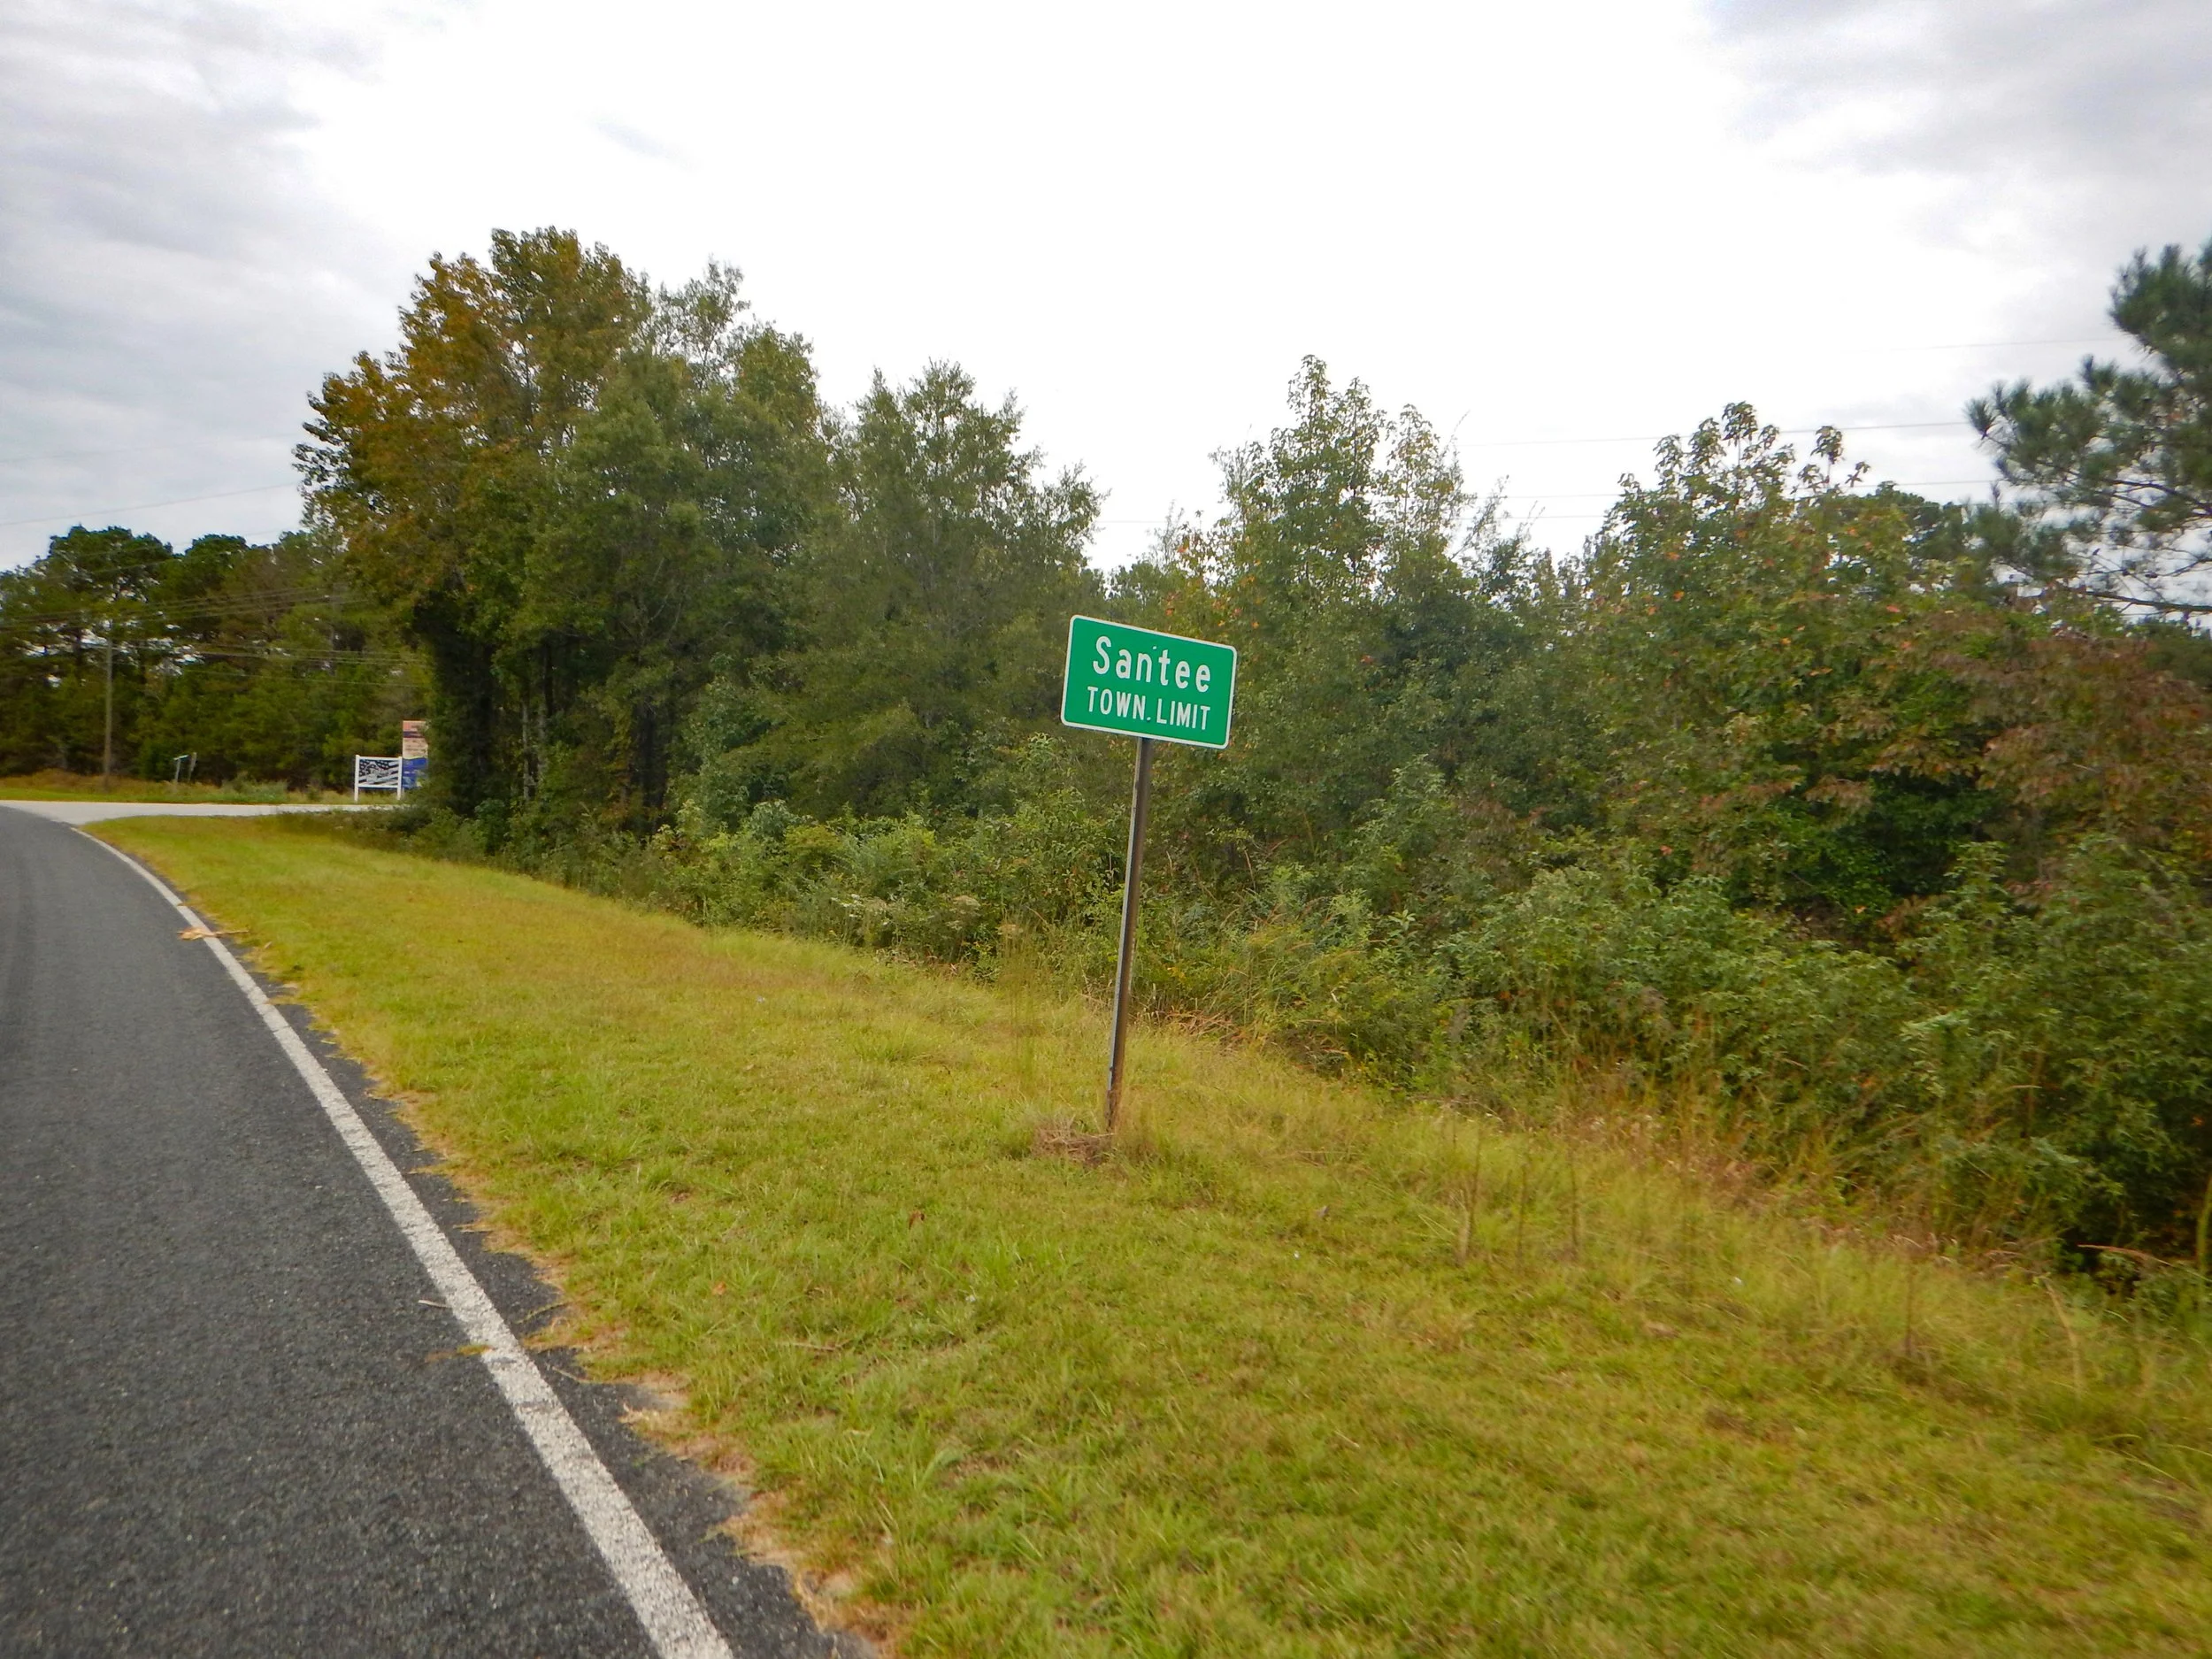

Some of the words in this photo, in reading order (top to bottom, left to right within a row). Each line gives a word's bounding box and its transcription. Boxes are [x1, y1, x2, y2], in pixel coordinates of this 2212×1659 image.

[1093, 636, 1210, 693] Santee
[1087, 686, 1146, 720] TOWN
[1156, 698, 1211, 730] LIMIT
